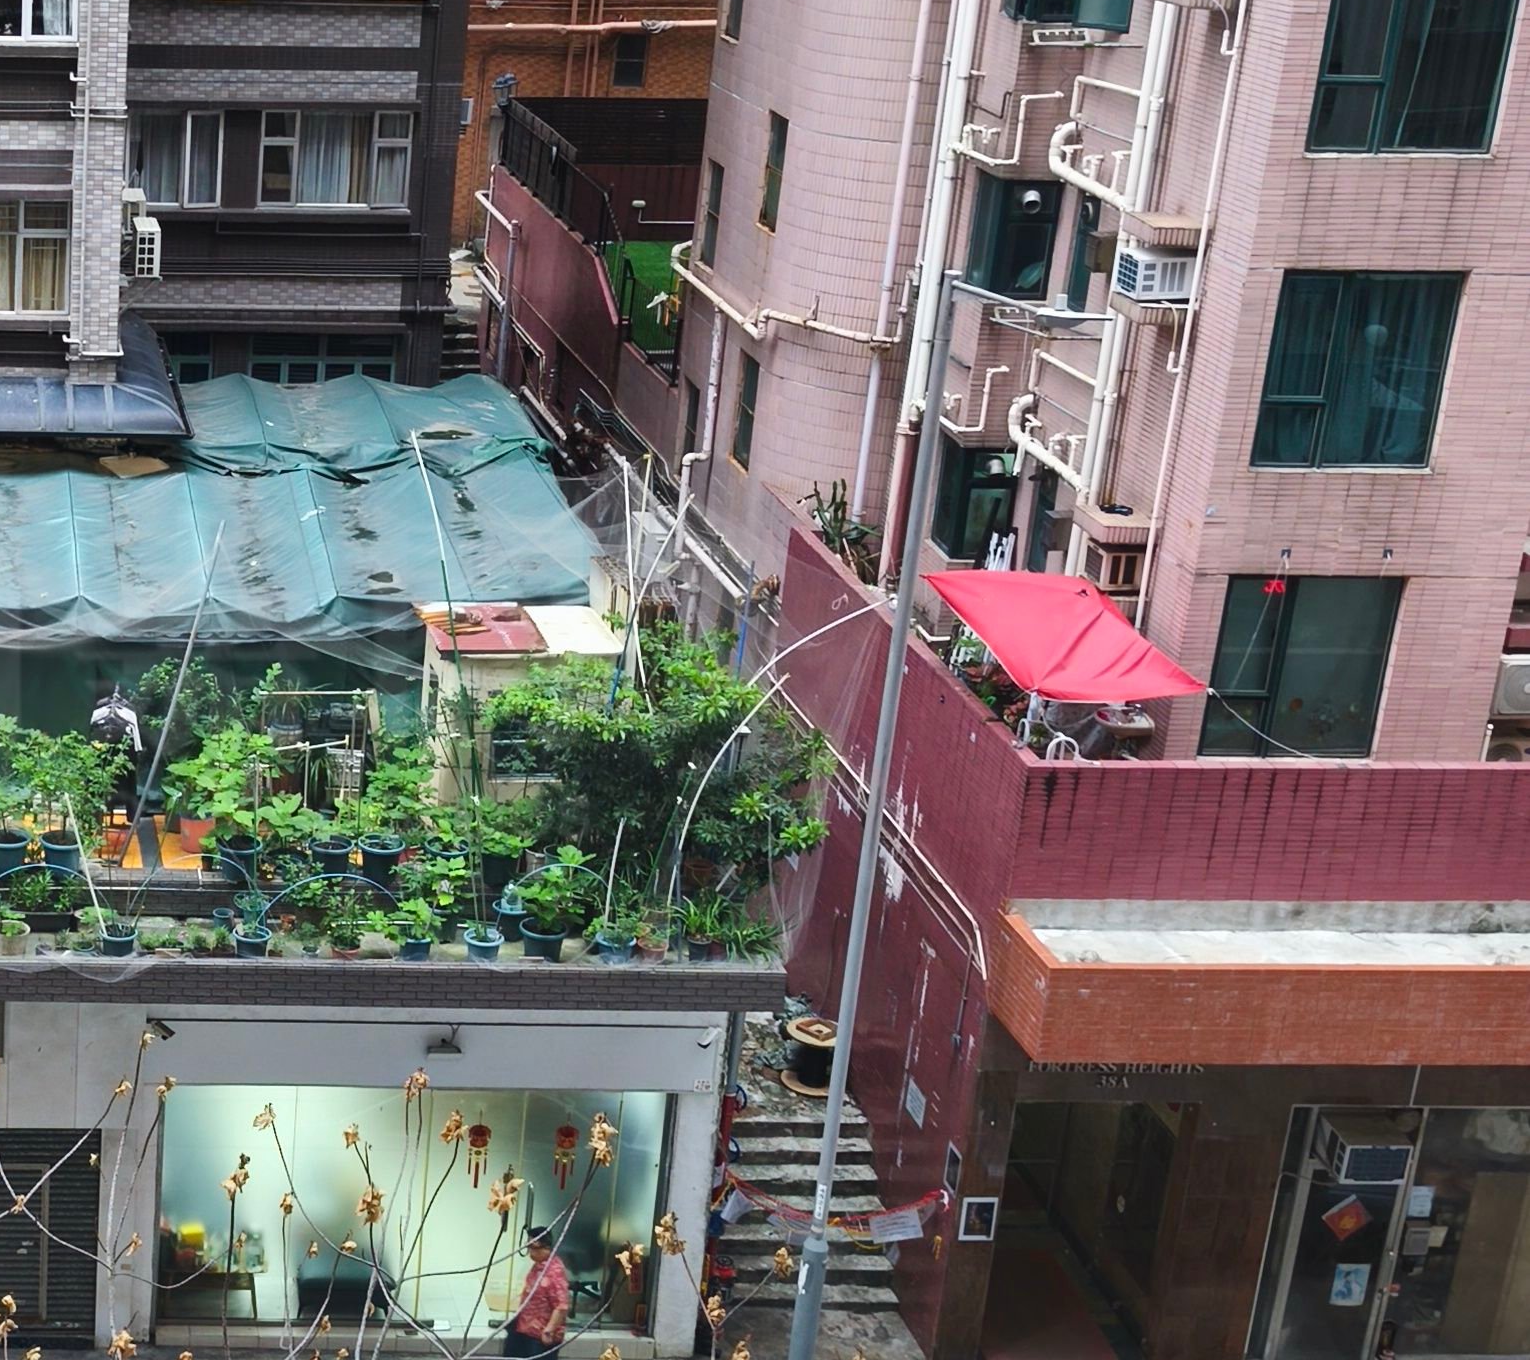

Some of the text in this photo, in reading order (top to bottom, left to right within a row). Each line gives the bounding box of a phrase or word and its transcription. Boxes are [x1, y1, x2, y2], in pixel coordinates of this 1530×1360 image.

[1028, 1061, 1205, 1074] FORTRESS HEIGHTS
[1097, 1076, 1130, 1089] 38A
